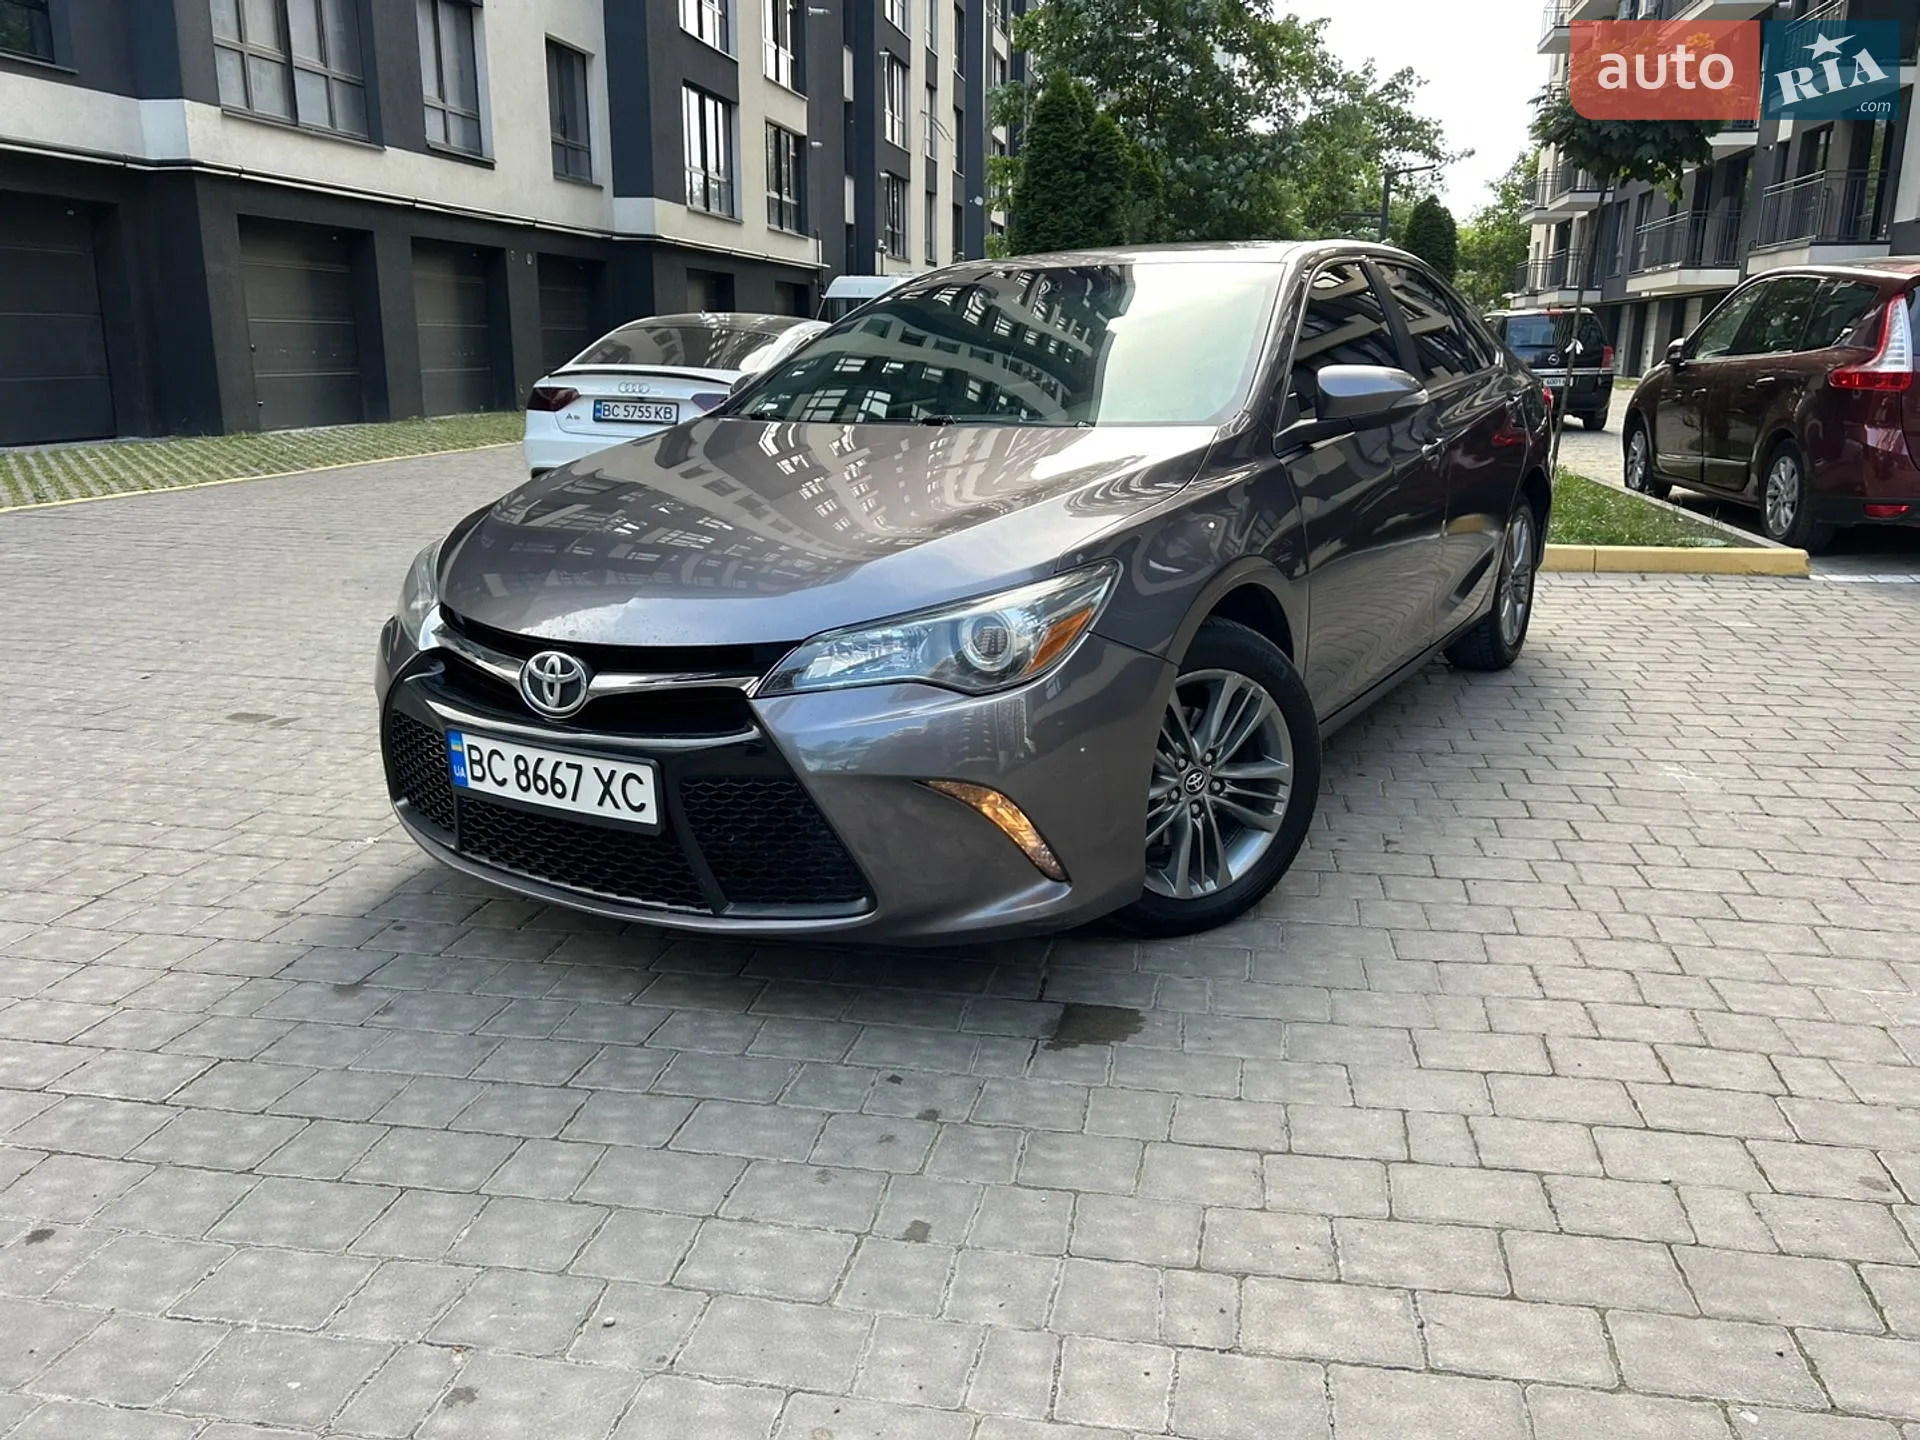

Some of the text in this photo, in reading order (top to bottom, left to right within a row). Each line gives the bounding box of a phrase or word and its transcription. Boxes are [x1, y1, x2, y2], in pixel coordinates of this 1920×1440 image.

[602, 404, 673, 420] BC 5755 KB
[466, 743, 647, 813] BC 8667 XC
